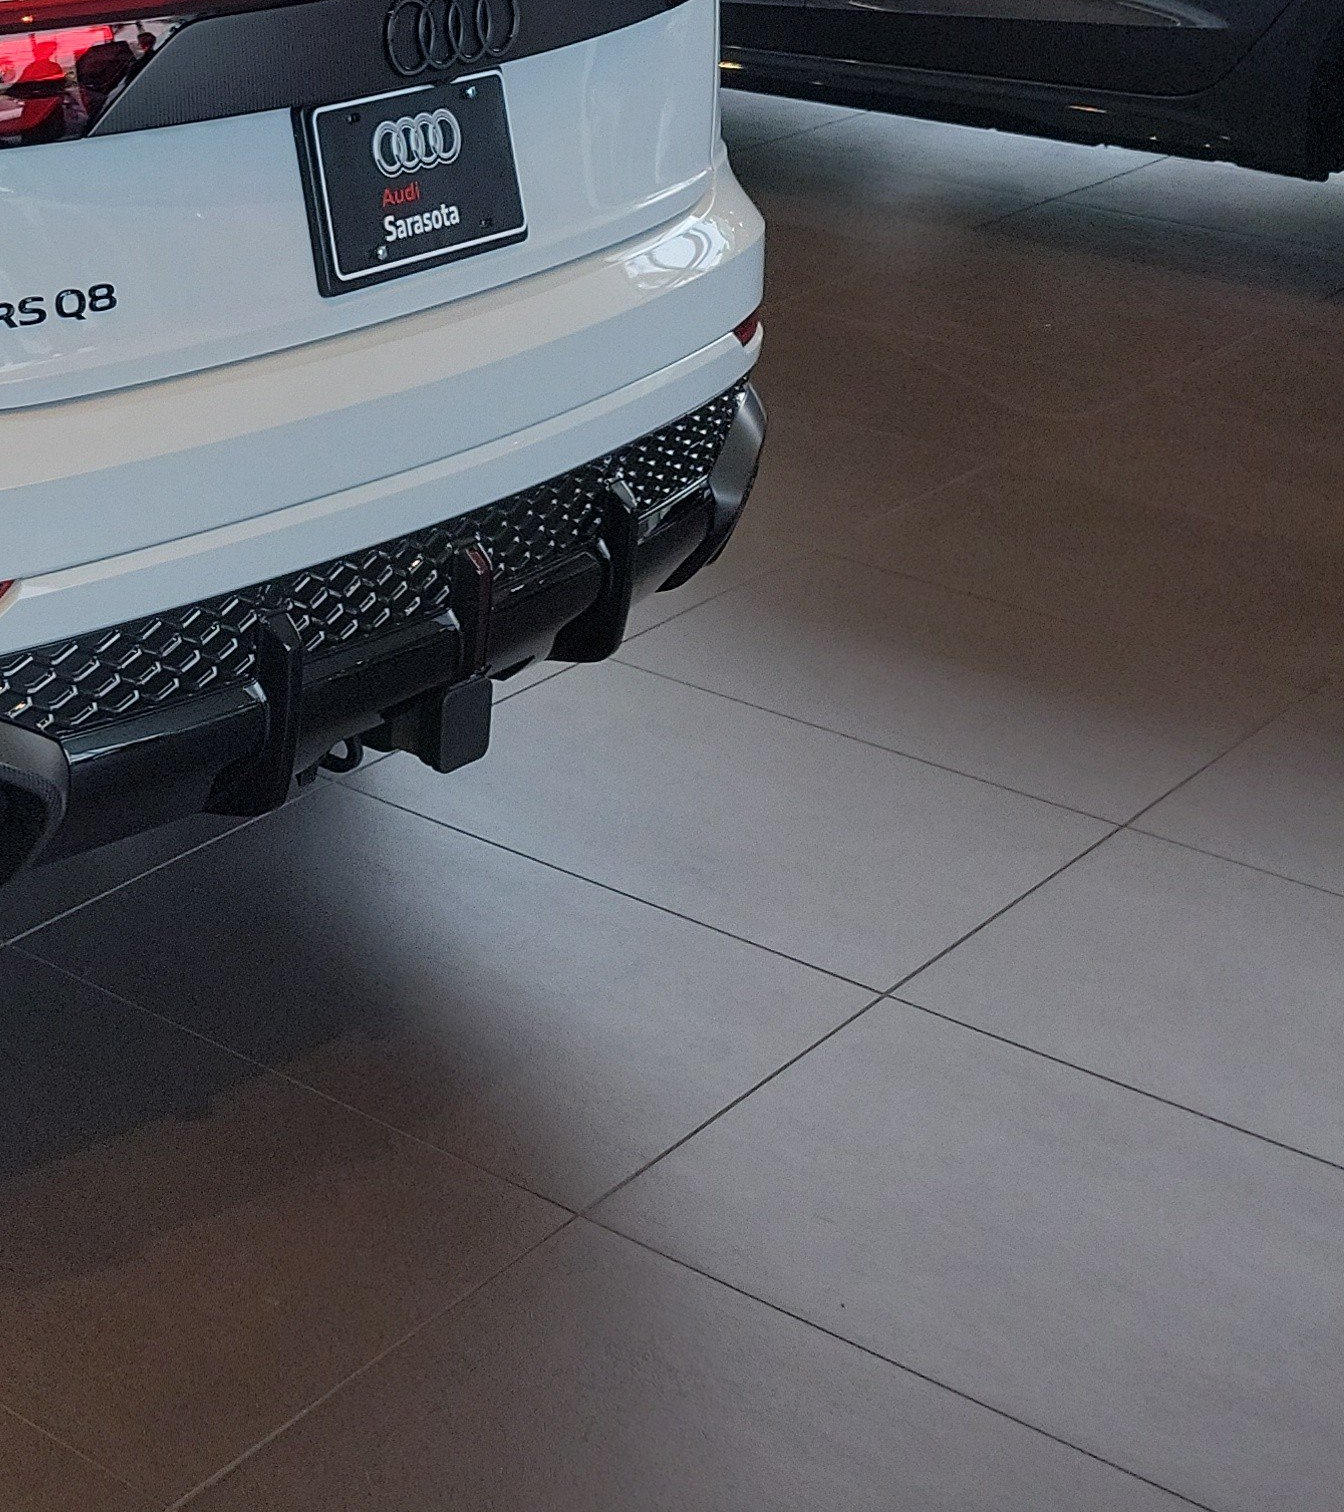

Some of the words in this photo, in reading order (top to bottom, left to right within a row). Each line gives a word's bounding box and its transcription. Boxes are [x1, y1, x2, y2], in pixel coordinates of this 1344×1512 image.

[382, 181, 420, 208] Audi
[384, 203, 460, 242] Sarasota
[55, 283, 117, 320] Q8
